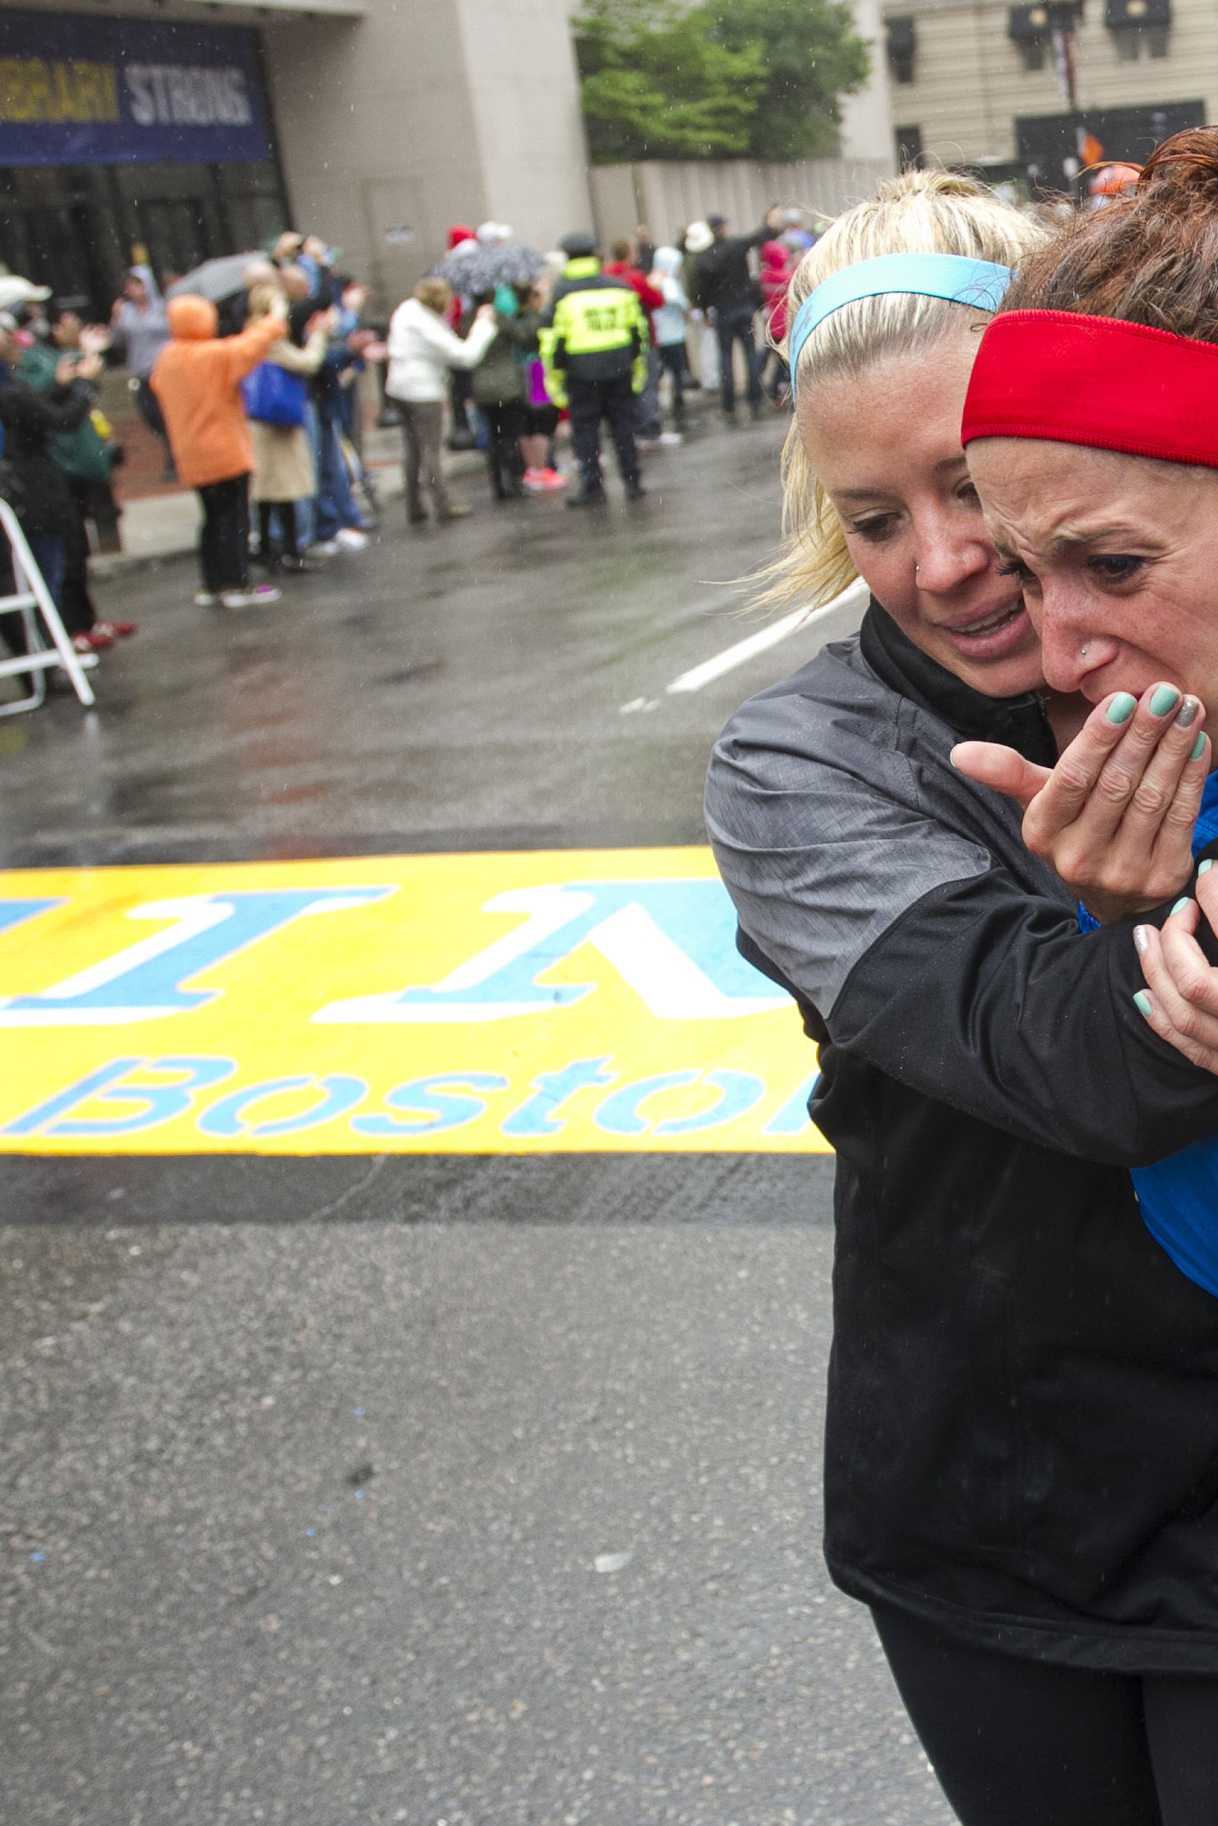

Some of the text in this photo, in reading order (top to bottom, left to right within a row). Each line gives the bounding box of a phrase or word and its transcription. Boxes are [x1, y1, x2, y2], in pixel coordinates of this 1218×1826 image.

[0, 57, 251, 126] BRARY STRONG
[2, 1055, 820, 1136] Bosto
